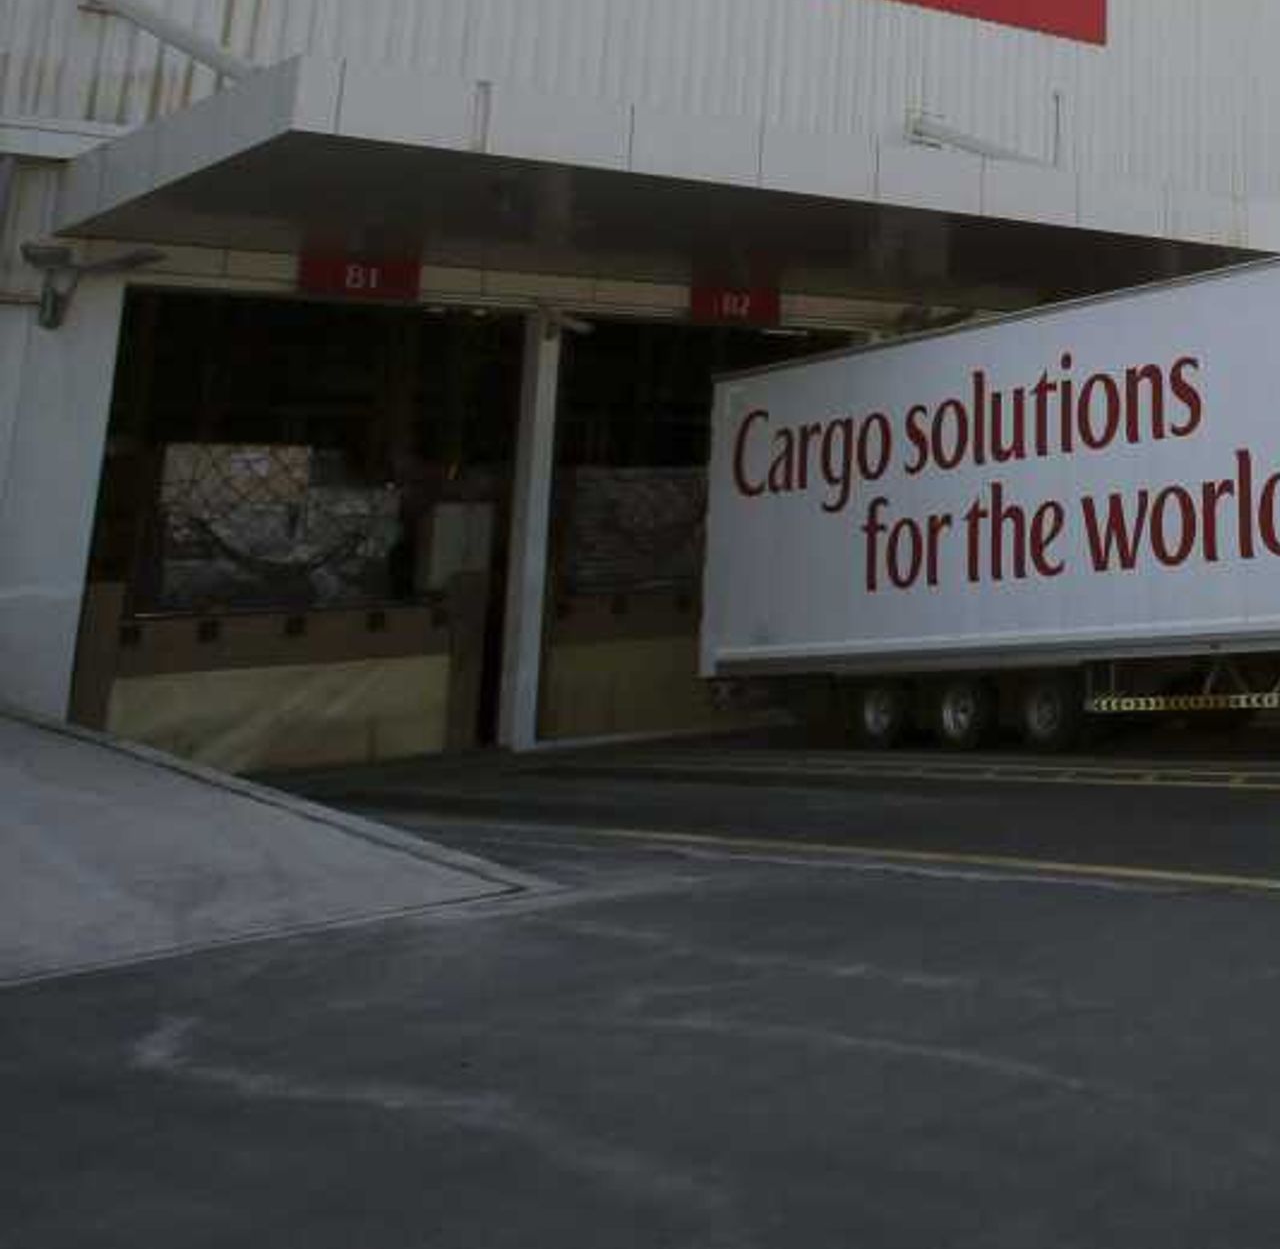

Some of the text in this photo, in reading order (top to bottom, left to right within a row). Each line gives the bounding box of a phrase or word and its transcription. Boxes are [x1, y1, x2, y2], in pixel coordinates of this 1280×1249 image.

[732, 352, 1202, 513] Cargo solutions
[861, 496, 951, 592] for
[963, 482, 1065, 582] the
